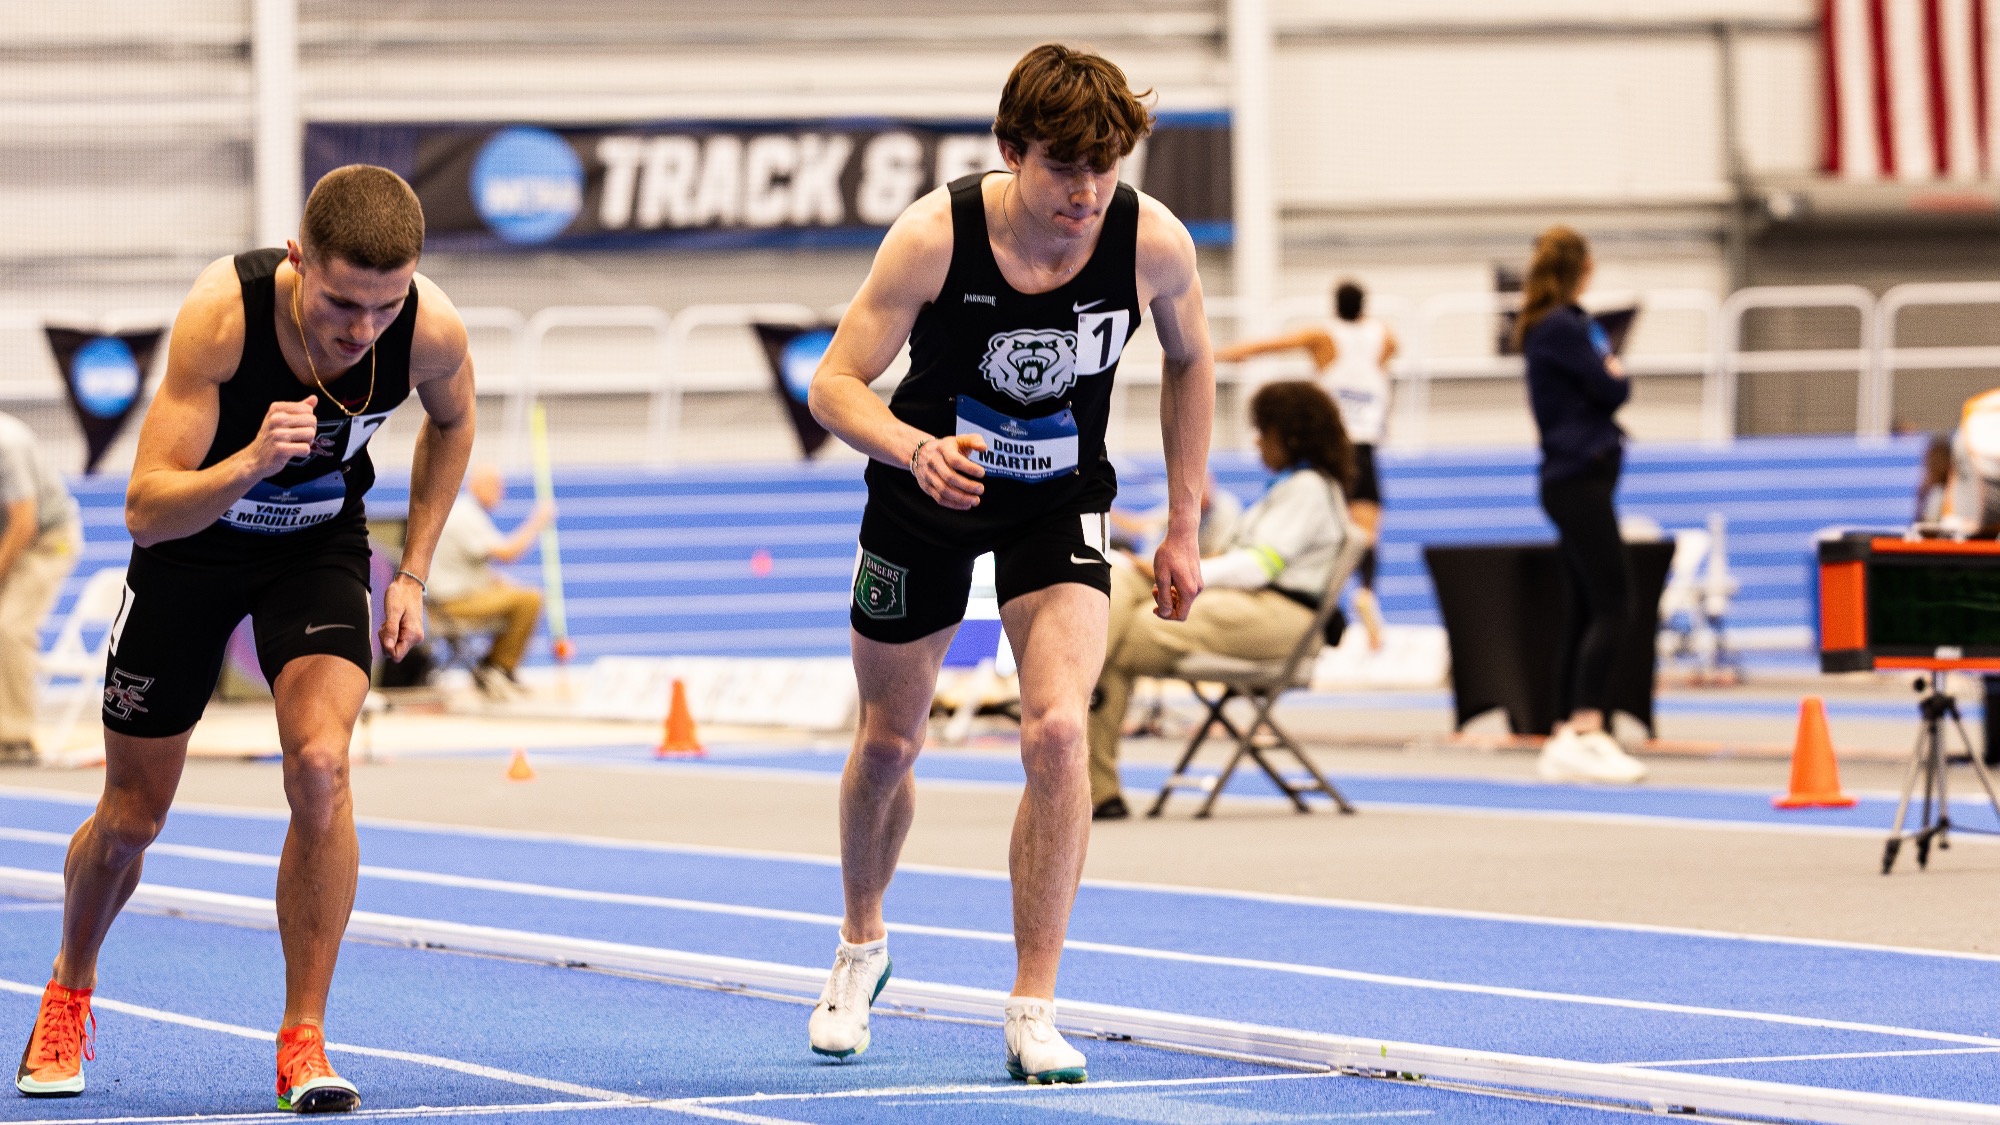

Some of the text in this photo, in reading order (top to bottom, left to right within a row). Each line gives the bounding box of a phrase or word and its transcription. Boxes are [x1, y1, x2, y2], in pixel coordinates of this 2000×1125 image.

[599, 135, 852, 227] TRACK
[858, 134, 924, 225] &
[963, 293, 997, 307] PARKSIDE
[1092, 317, 1113, 369] 1
[993, 438, 1035, 456] DOUG
[978, 450, 1052, 471] MARTIN
[256, 504, 302, 516] YANIS
[866, 556, 900, 583] RANGERS
